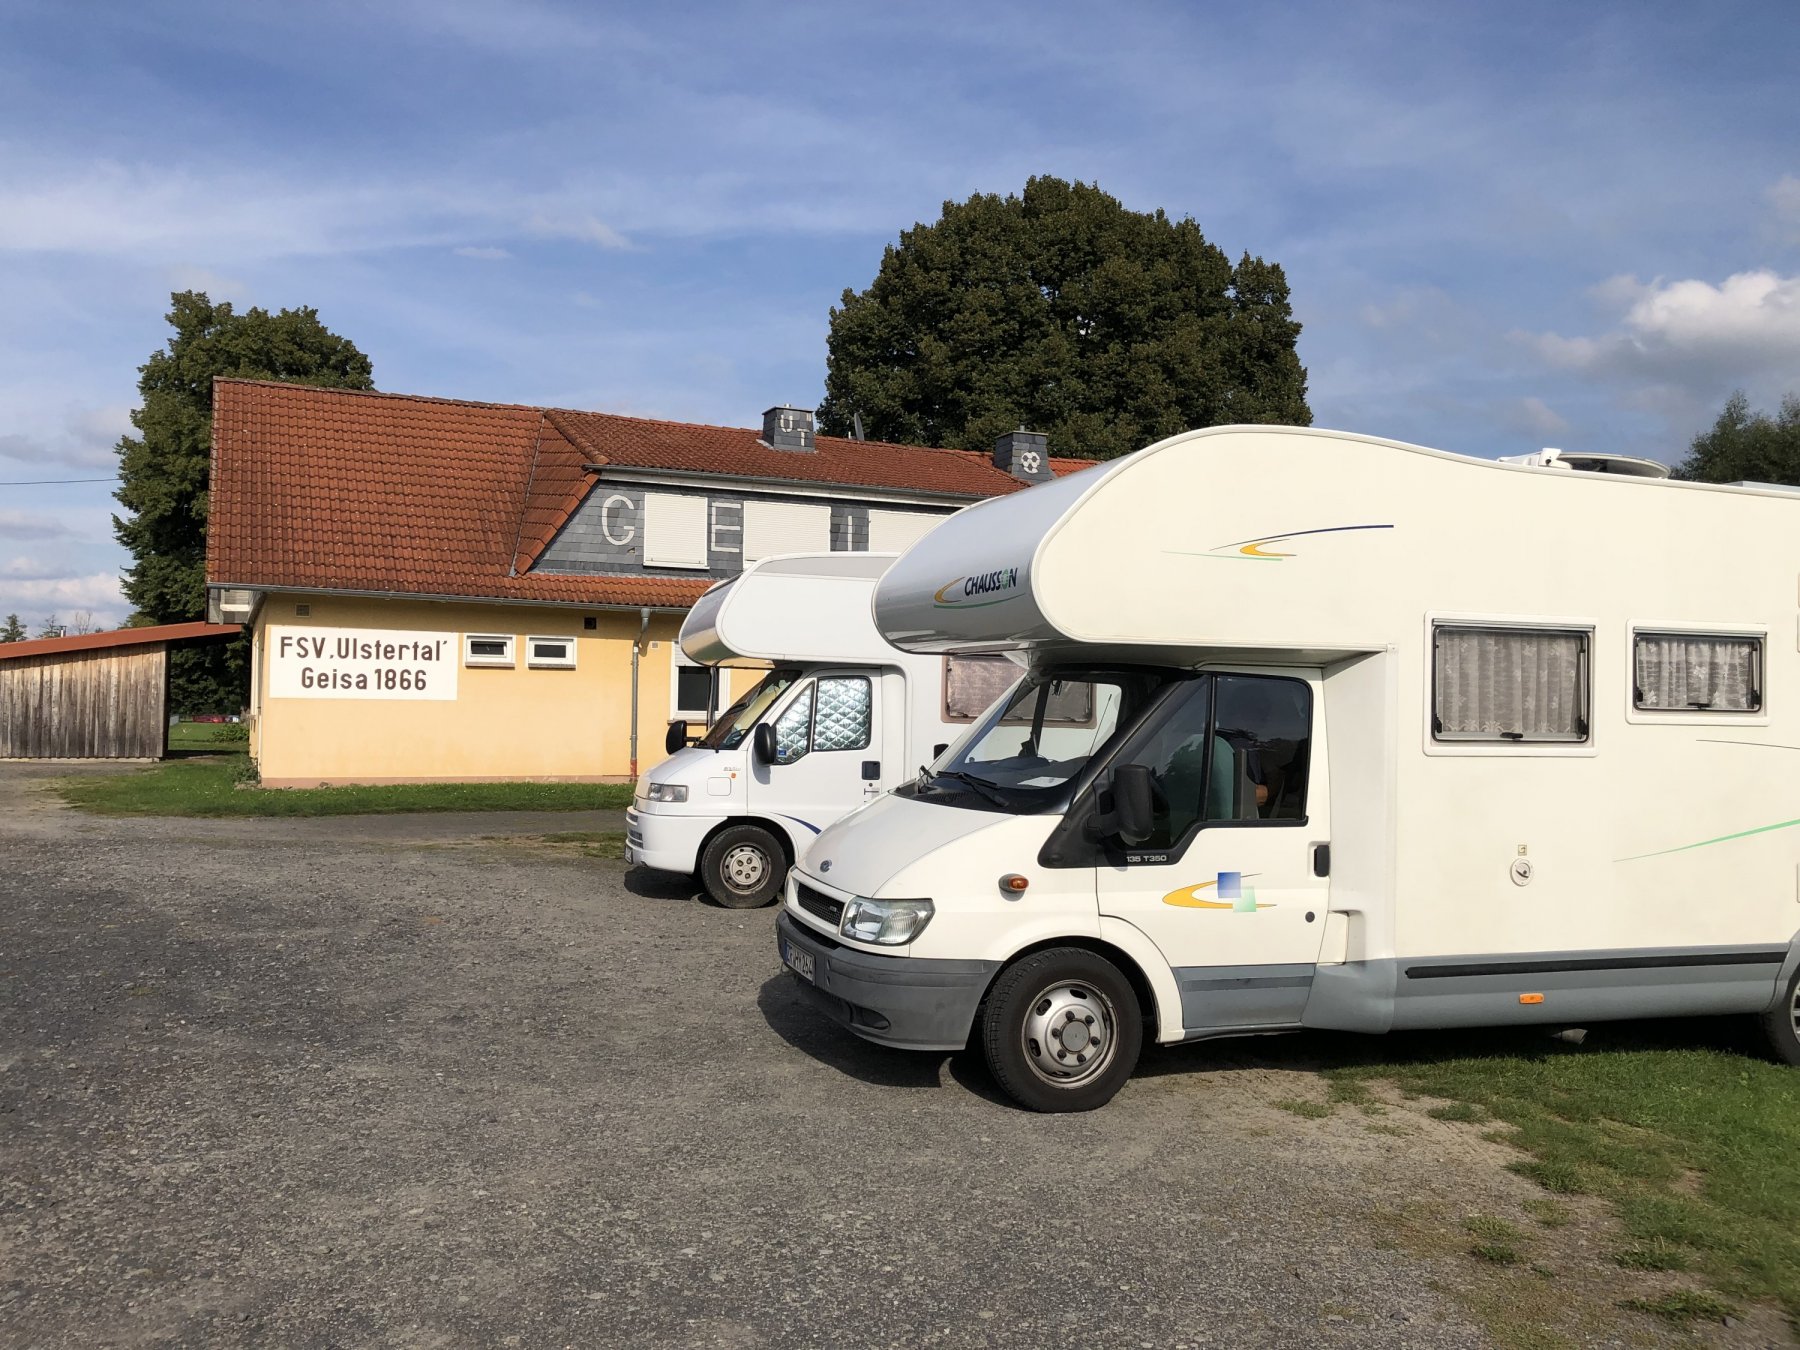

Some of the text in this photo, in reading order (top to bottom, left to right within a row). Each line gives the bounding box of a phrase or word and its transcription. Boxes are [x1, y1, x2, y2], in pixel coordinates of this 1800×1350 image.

[965, 567, 1018, 596] CHAUSSON
[301, 667, 427, 690] Geisa 1866
